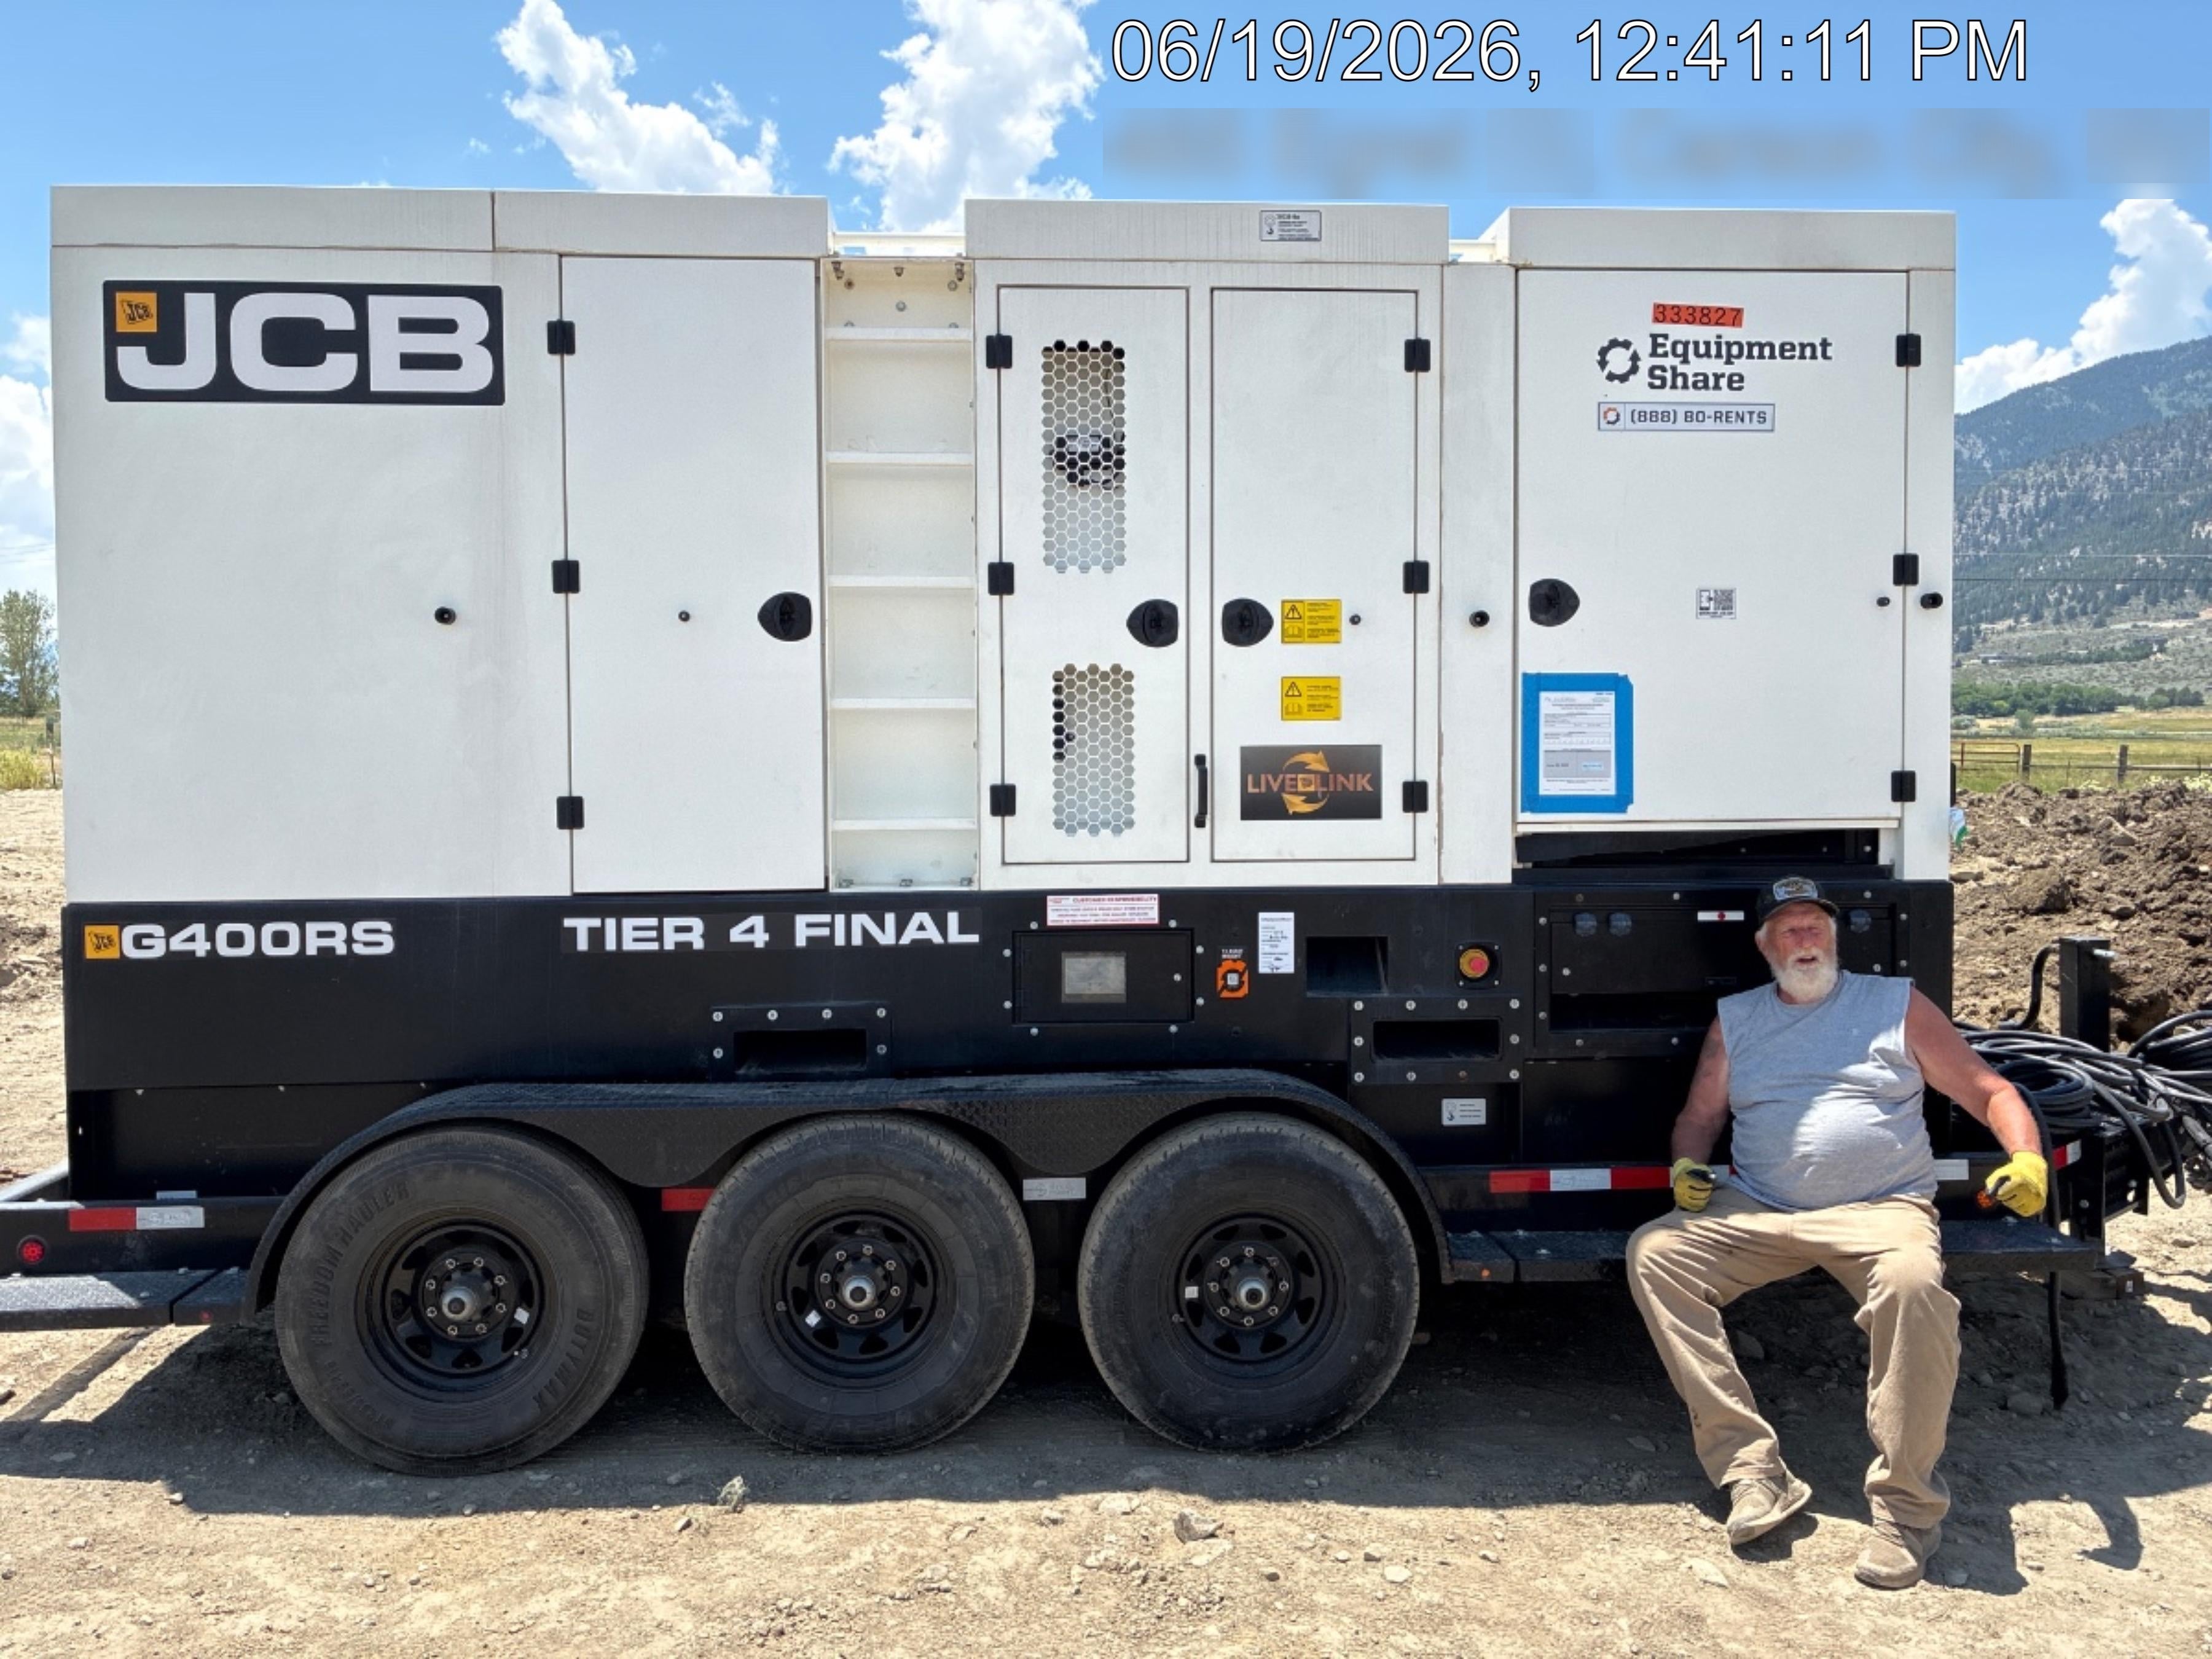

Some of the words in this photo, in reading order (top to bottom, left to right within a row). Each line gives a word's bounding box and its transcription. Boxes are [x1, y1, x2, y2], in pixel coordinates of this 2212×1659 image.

[1654, 304, 1741, 327] 333827
[117, 292, 493, 393] JCB
[1649, 333, 1832, 365] Equipment
[1648, 365, 1744, 391] Share
[1630, 409, 1677, 425] (888)
[1247, 773, 1298, 794] LIVE
[1316, 773, 1374, 793] LINK
[121, 920, 395, 959] G400RS
[563, 917, 705, 951] TIER
[729, 915, 769, 948] 4
[795, 911, 979, 947] FINAL
